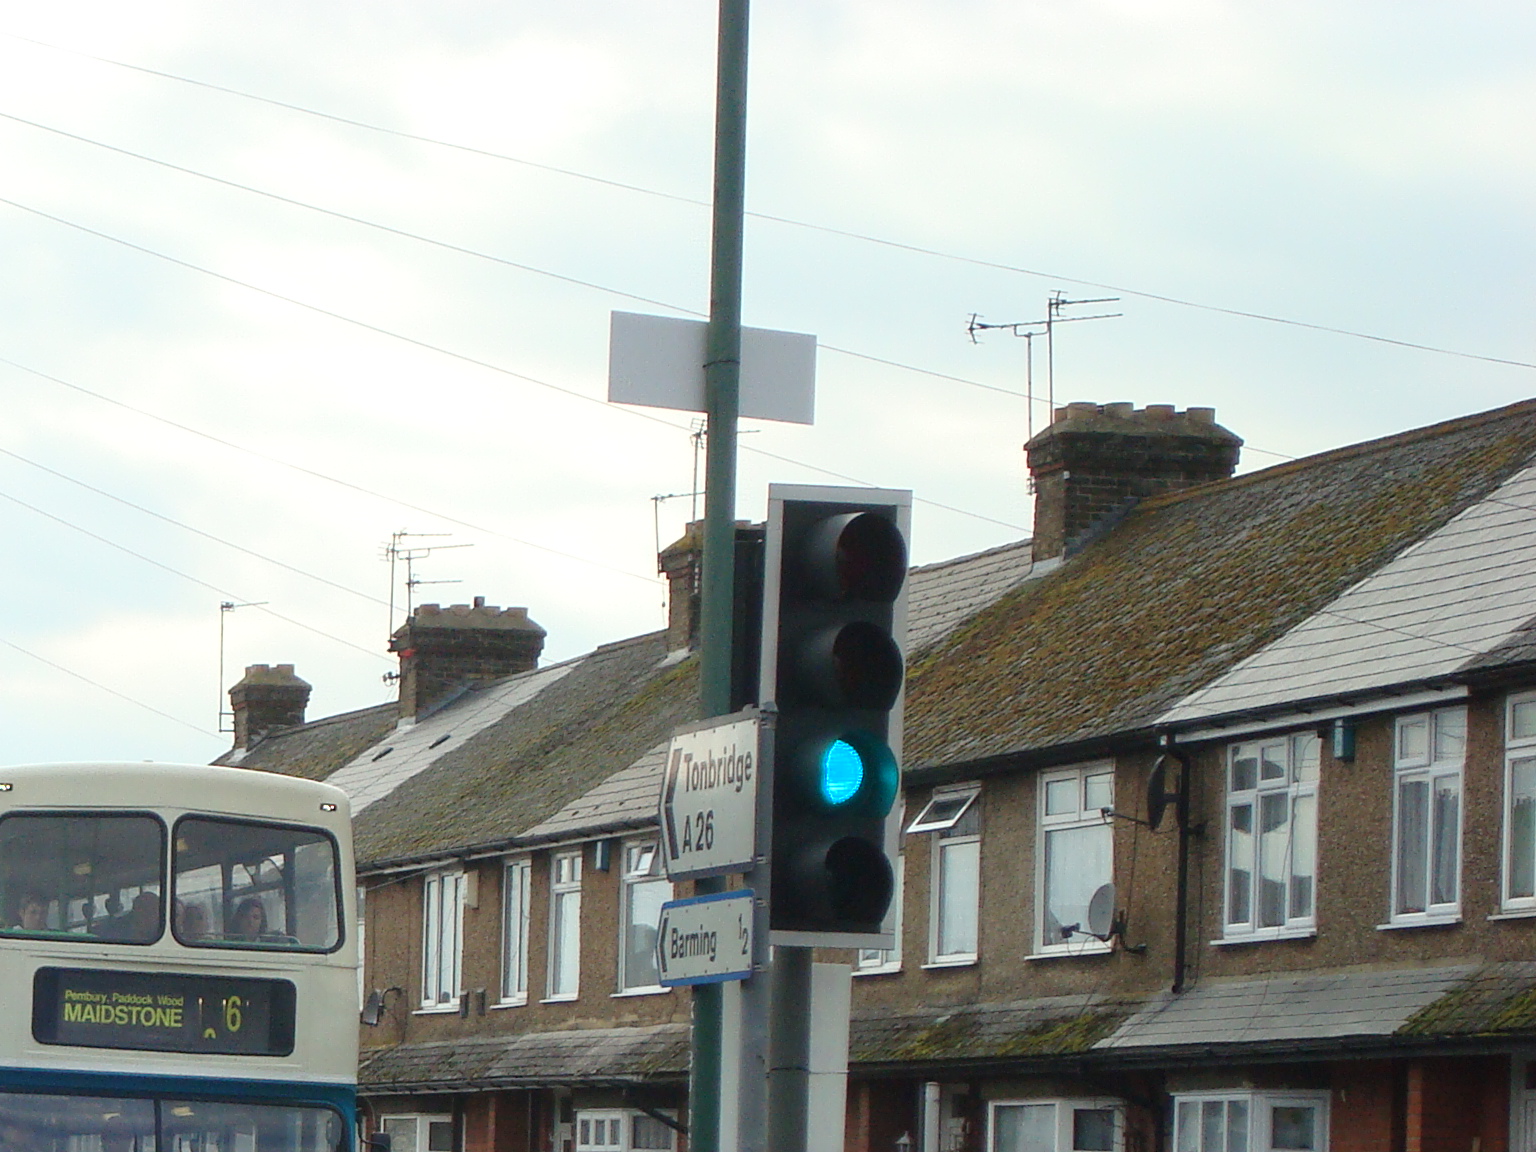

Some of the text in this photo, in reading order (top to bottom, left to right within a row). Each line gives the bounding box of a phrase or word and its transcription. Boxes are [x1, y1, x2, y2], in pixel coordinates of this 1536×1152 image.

[684, 743, 752, 793] Tonbridge
[670, 924, 717, 962] Barming
[112, 992, 152, 1005] Paddock
[157, 994, 184, 1007] Wood
[64, 1003, 183, 1028] MAIDSTONE
